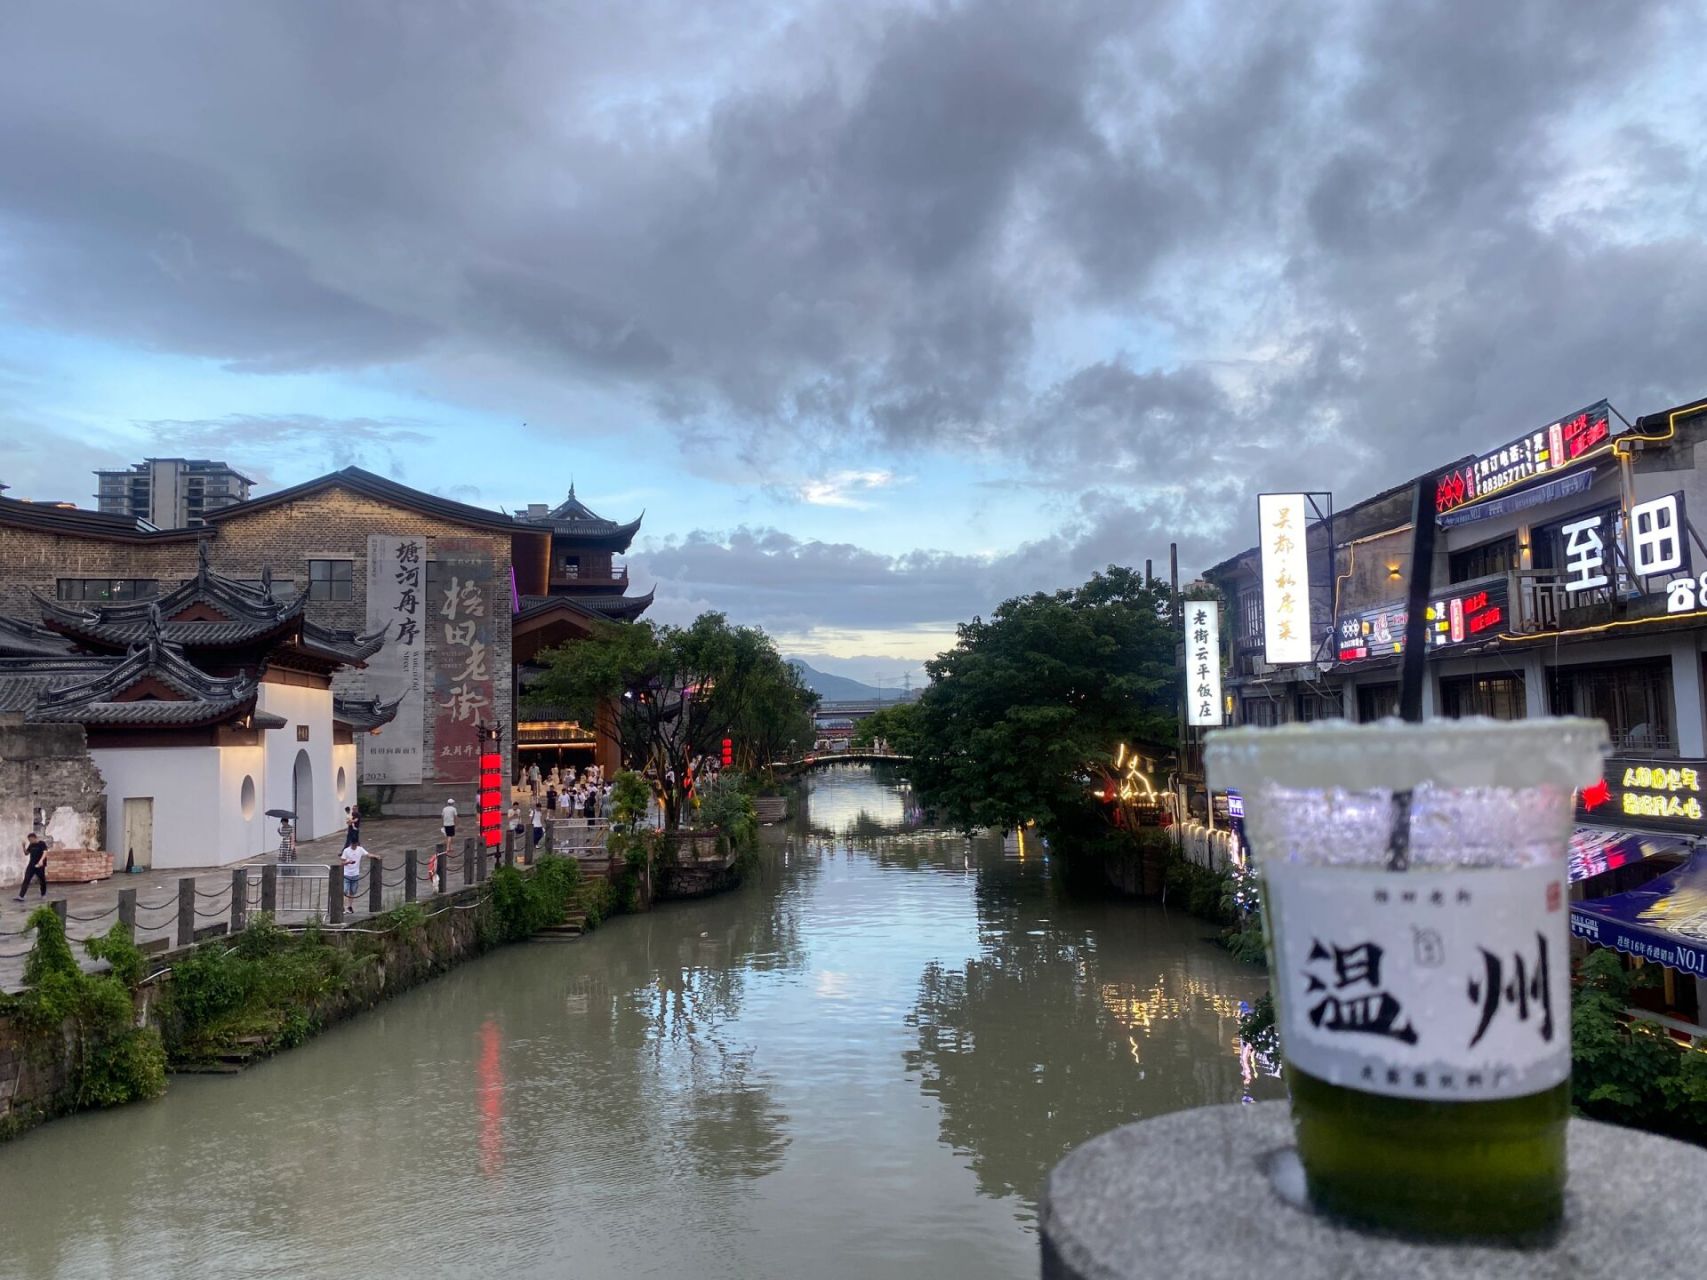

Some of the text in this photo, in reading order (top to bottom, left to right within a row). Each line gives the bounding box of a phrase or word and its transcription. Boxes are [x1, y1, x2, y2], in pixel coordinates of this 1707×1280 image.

[1482, 463, 1526, 495] 88305771
[393, 541, 423, 646] 塘河再序
[440, 576, 490, 727] 梧田老街
[1193, 609, 1213, 718] 老街云平饭庄
[1300, 928, 1555, 1049] 温州
[1675, 946, 1705, 973] NO.1
